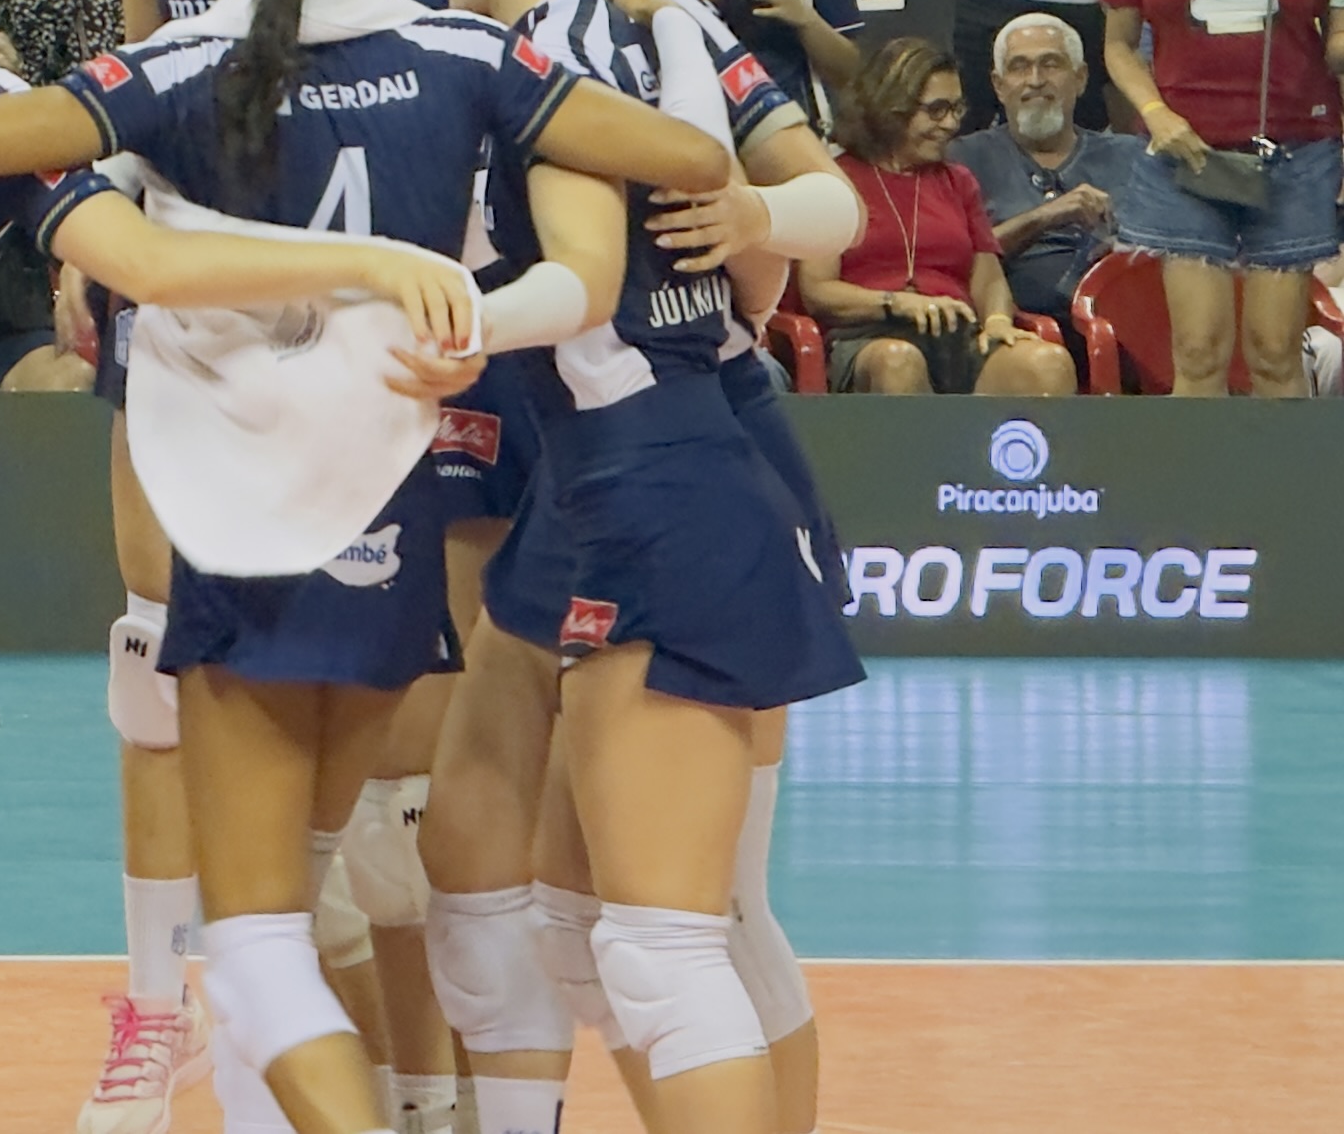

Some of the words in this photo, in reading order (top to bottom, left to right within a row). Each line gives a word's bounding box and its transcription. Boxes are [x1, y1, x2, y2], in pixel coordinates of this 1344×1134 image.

[298, 69, 420, 110] GERDAU
[307, 144, 373, 237] 4
[938, 484, 1099, 519] Piracanjuba
[335, 544, 387, 565] mbé
